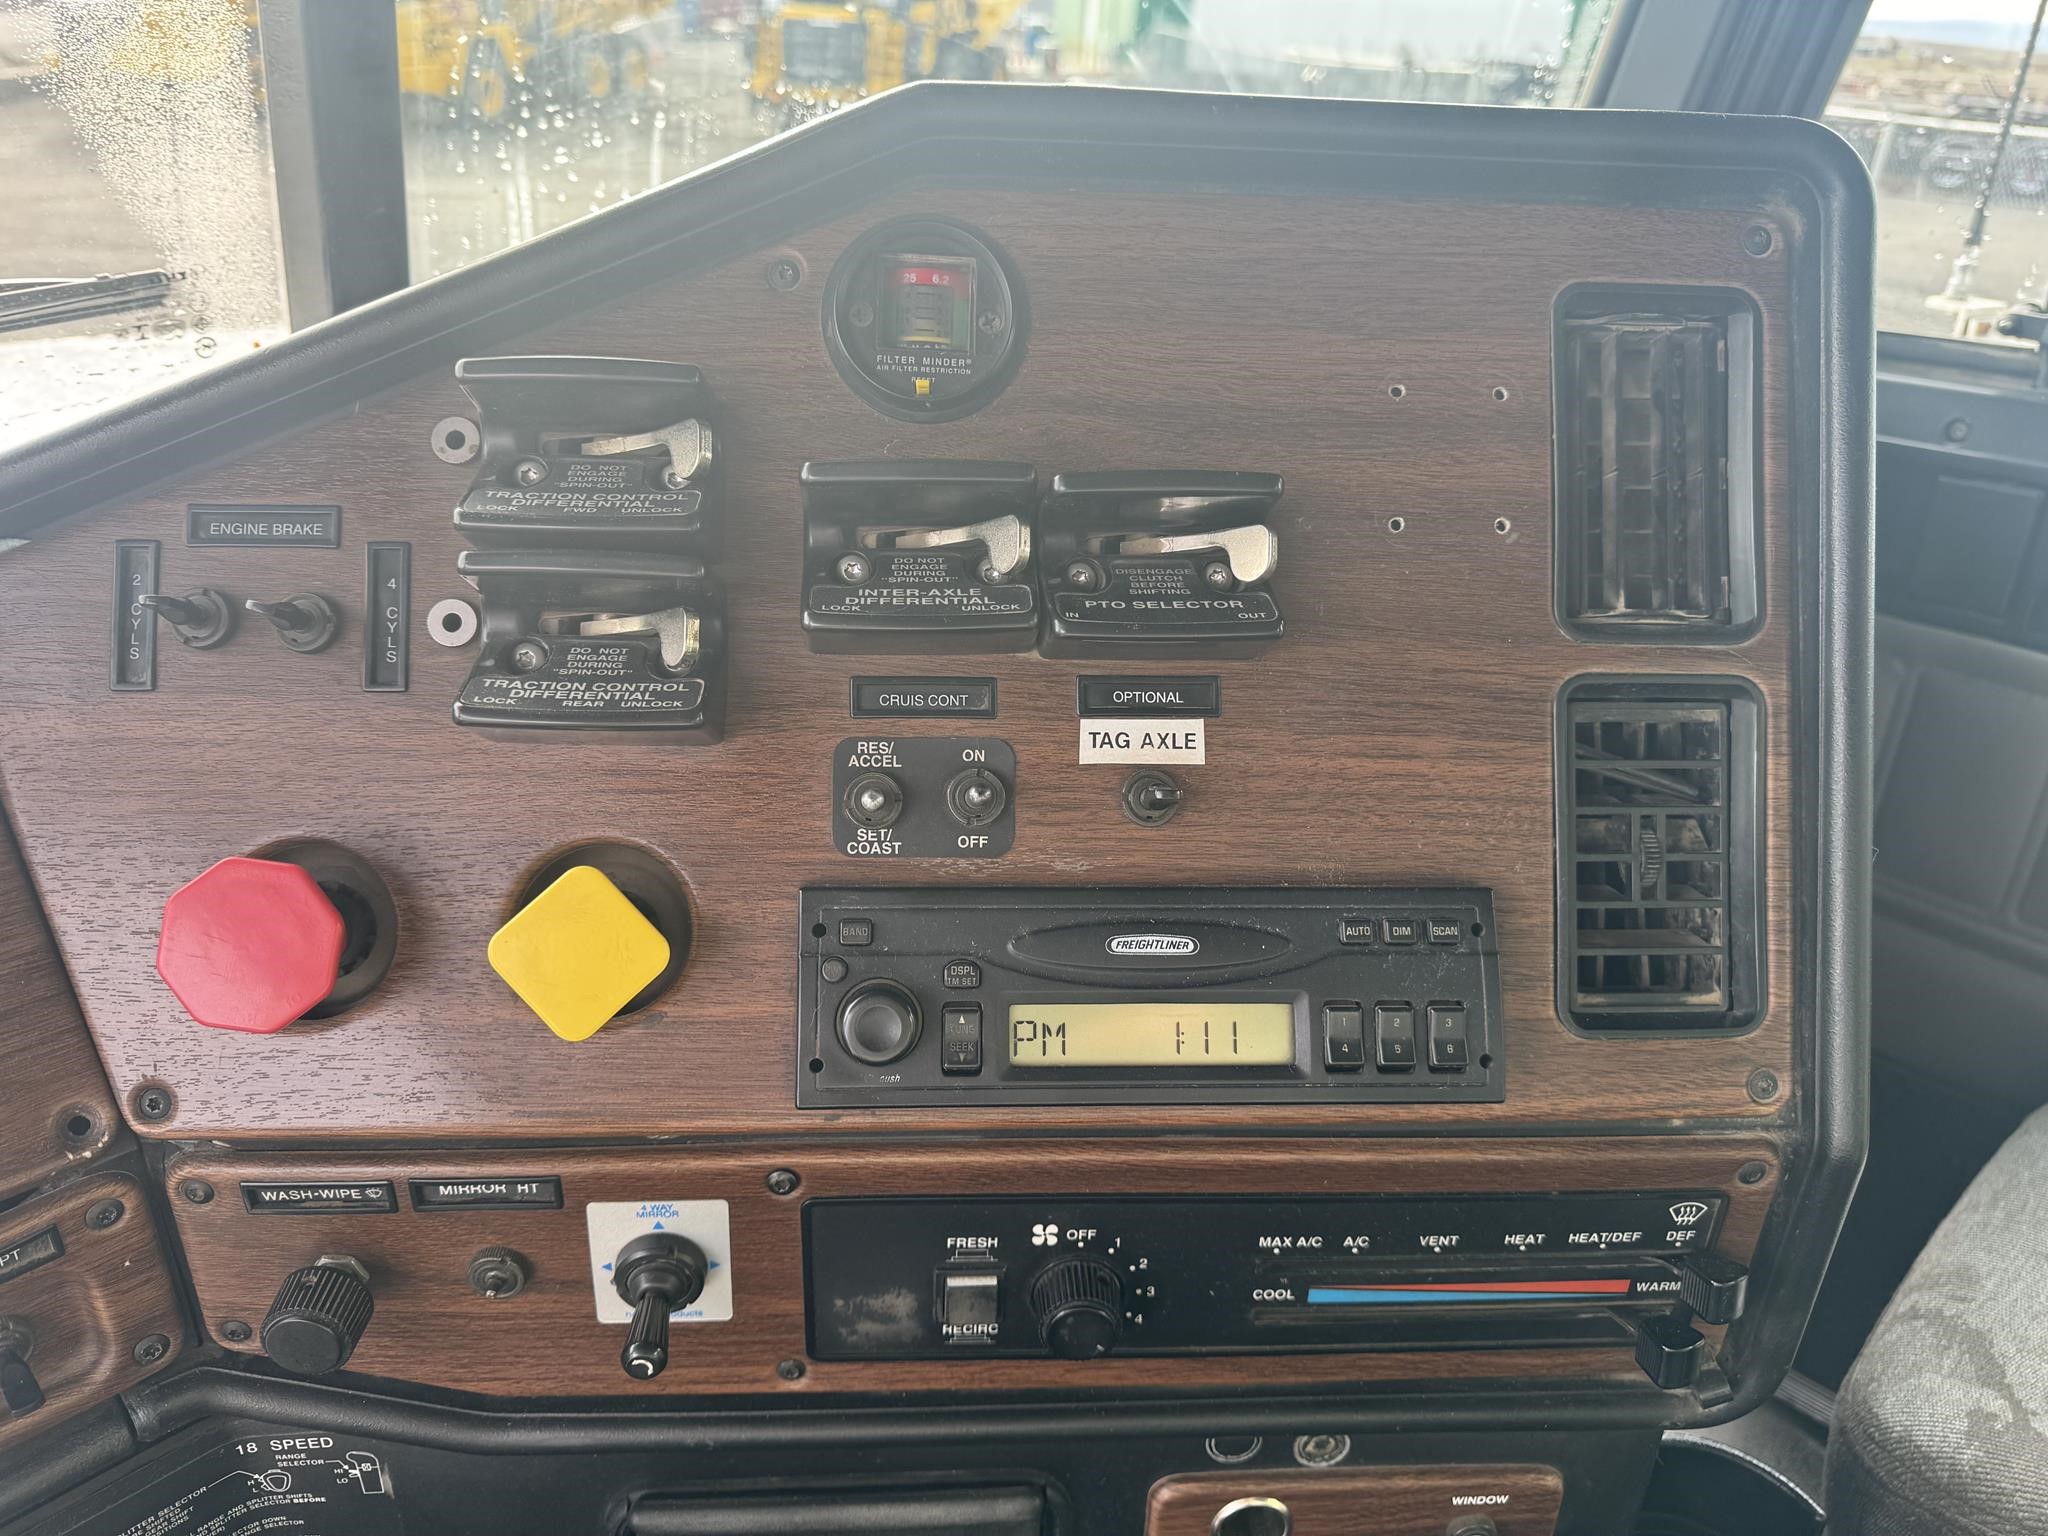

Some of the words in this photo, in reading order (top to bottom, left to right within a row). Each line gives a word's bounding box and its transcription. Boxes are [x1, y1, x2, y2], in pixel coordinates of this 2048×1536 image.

[903, 273, 917, 283] 25
[876, 355, 915, 365] FILTER
[891, 365, 918, 373] FILTER
[921, 366, 971, 375] RESTRICTION
[485, 490, 589, 501] TRACTION
[592, 492, 689, 501] CONTROL
[511, 499, 656, 508] DIFFERENTIAL
[210, 523, 268, 536] ENGINE
[273, 524, 323, 536] BRAKE
[133, 574, 141, 586] 2
[387, 578, 397, 589] 4
[845, 597, 995, 605] DIFFERENTIAL
[1085, 601, 1126, 609] PTO
[1133, 600, 1244, 609] SELECTOR
[961, 604, 1020, 612] UNLOCK
[129, 603, 142, 660] CYLS
[386, 607, 398, 663] CYLS
[566, 654, 628, 662] ENGAGE
[567, 661, 623, 669] DURING
[482, 678, 588, 691] TRACTION
[592, 682, 690, 692] CONTROL
[509, 690, 655, 700] DIFFERENTIAL
[879, 694, 923, 707] CRUIS
[927, 694, 969, 707] CONT
[1112, 690, 1184, 704] OPTIONAL
[474, 696, 517, 705] LOCK
[621, 700, 683, 708] UNLOCK
[1088, 731, 1130, 750] TAG
[1140, 732, 1197, 750] AXLE
[857, 741, 894, 755] RES/
[848, 754, 902, 768] ACCEL
[962, 749, 985, 763] ON
[856, 829, 892, 842] SET/
[957, 835, 989, 849] OFF
[847, 841, 902, 855] COAST
[843, 928, 868, 937] BAND
[1346, 927, 1371, 936] AUTO
[1392, 927, 1411, 936] DIM
[1433, 927, 1458, 936] SCAN
[1115, 938, 1190, 951] FREIGHTLINER
[950, 966, 976, 976] DSPL
[962, 977, 976, 985] SET
[1013, 1020, 1066, 1057] PM
[1176, 1021, 1238, 1055] 1:11
[950, 1042, 975, 1052] SEEK
[262, 1188, 362, 1201] WASH-WIPE
[650, 1203, 674, 1211] WAY
[636, 1210, 680, 1218] MIRROR
[1066, 1229, 1097, 1241] OFF
[1419, 1235, 1459, 1246] VENT
[1504, 1234, 1546, 1245] HEAT
[1568, 1232, 1642, 1243] HEAT/DEF
[1666, 1231, 1696, 1241] DEF
[947, 1237, 998, 1248] FRESH
[1259, 1237, 1292, 1247] MAX
[1296, 1236, 1324, 1247] A/C
[1343, 1236, 1370, 1247] A/C
[1139, 1258, 1148, 1269] 2
[1146, 1286, 1155, 1297] 3
[1637, 1281, 1681, 1292] WARM
[1252, 1289, 1296, 1300] COOL
[1134, 1313, 1143, 1324] 4
[942, 1324, 999, 1335] RECIRC
[235, 1442, 258, 1455] 18
[270, 1437, 334, 1451] SPEED
[277, 1459, 325, 1468] SELECTOR
[1452, 1494, 1509, 1506] WINDOW
[118, 1516, 155, 1536] LITTER
[157, 1486, 207, 1518] SELECTOR
[197, 1513, 225, 1532] RANGE
[227, 1504, 244, 1516] AND
[246, 1494, 284, 1506] SPLITTER
[210, 1508, 248, 1531] SPLITTER
[250, 1499, 291, 1511] SELECTOR
[145, 1521, 169, 1536] GEAR
[170, 1505, 194, 1522] SHIFT
[146, 1508, 181, 1531] SHIFTED
[261, 1516, 287, 1525] DOWN
[264, 1519, 305, 1529] SELECTOR
[151, 1515, 189, 1536] SITIONS
